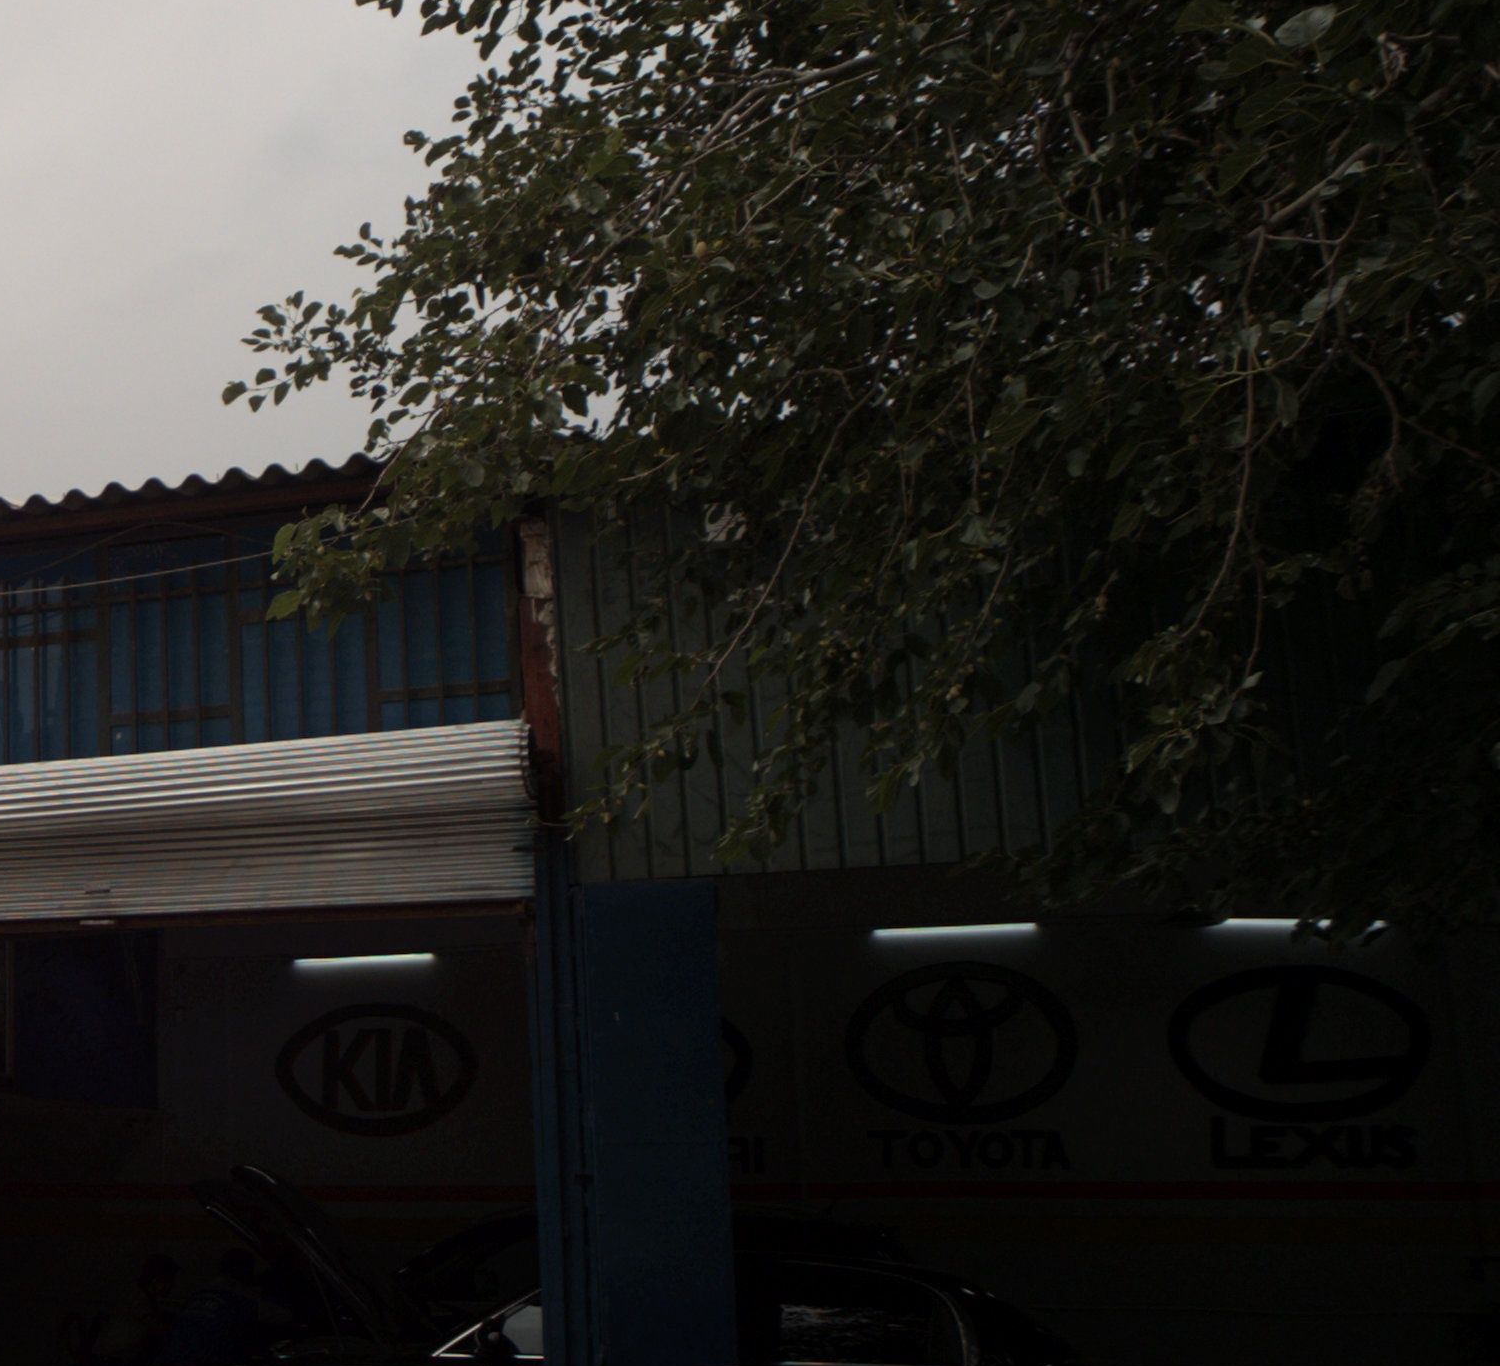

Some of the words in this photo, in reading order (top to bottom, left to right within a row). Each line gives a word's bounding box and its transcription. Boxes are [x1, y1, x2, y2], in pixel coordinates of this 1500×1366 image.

[322, 1026, 439, 1112] KIA
[866, 1129, 1070, 1172] TOYOTA
[1210, 1116, 1418, 1170] LEXUS
